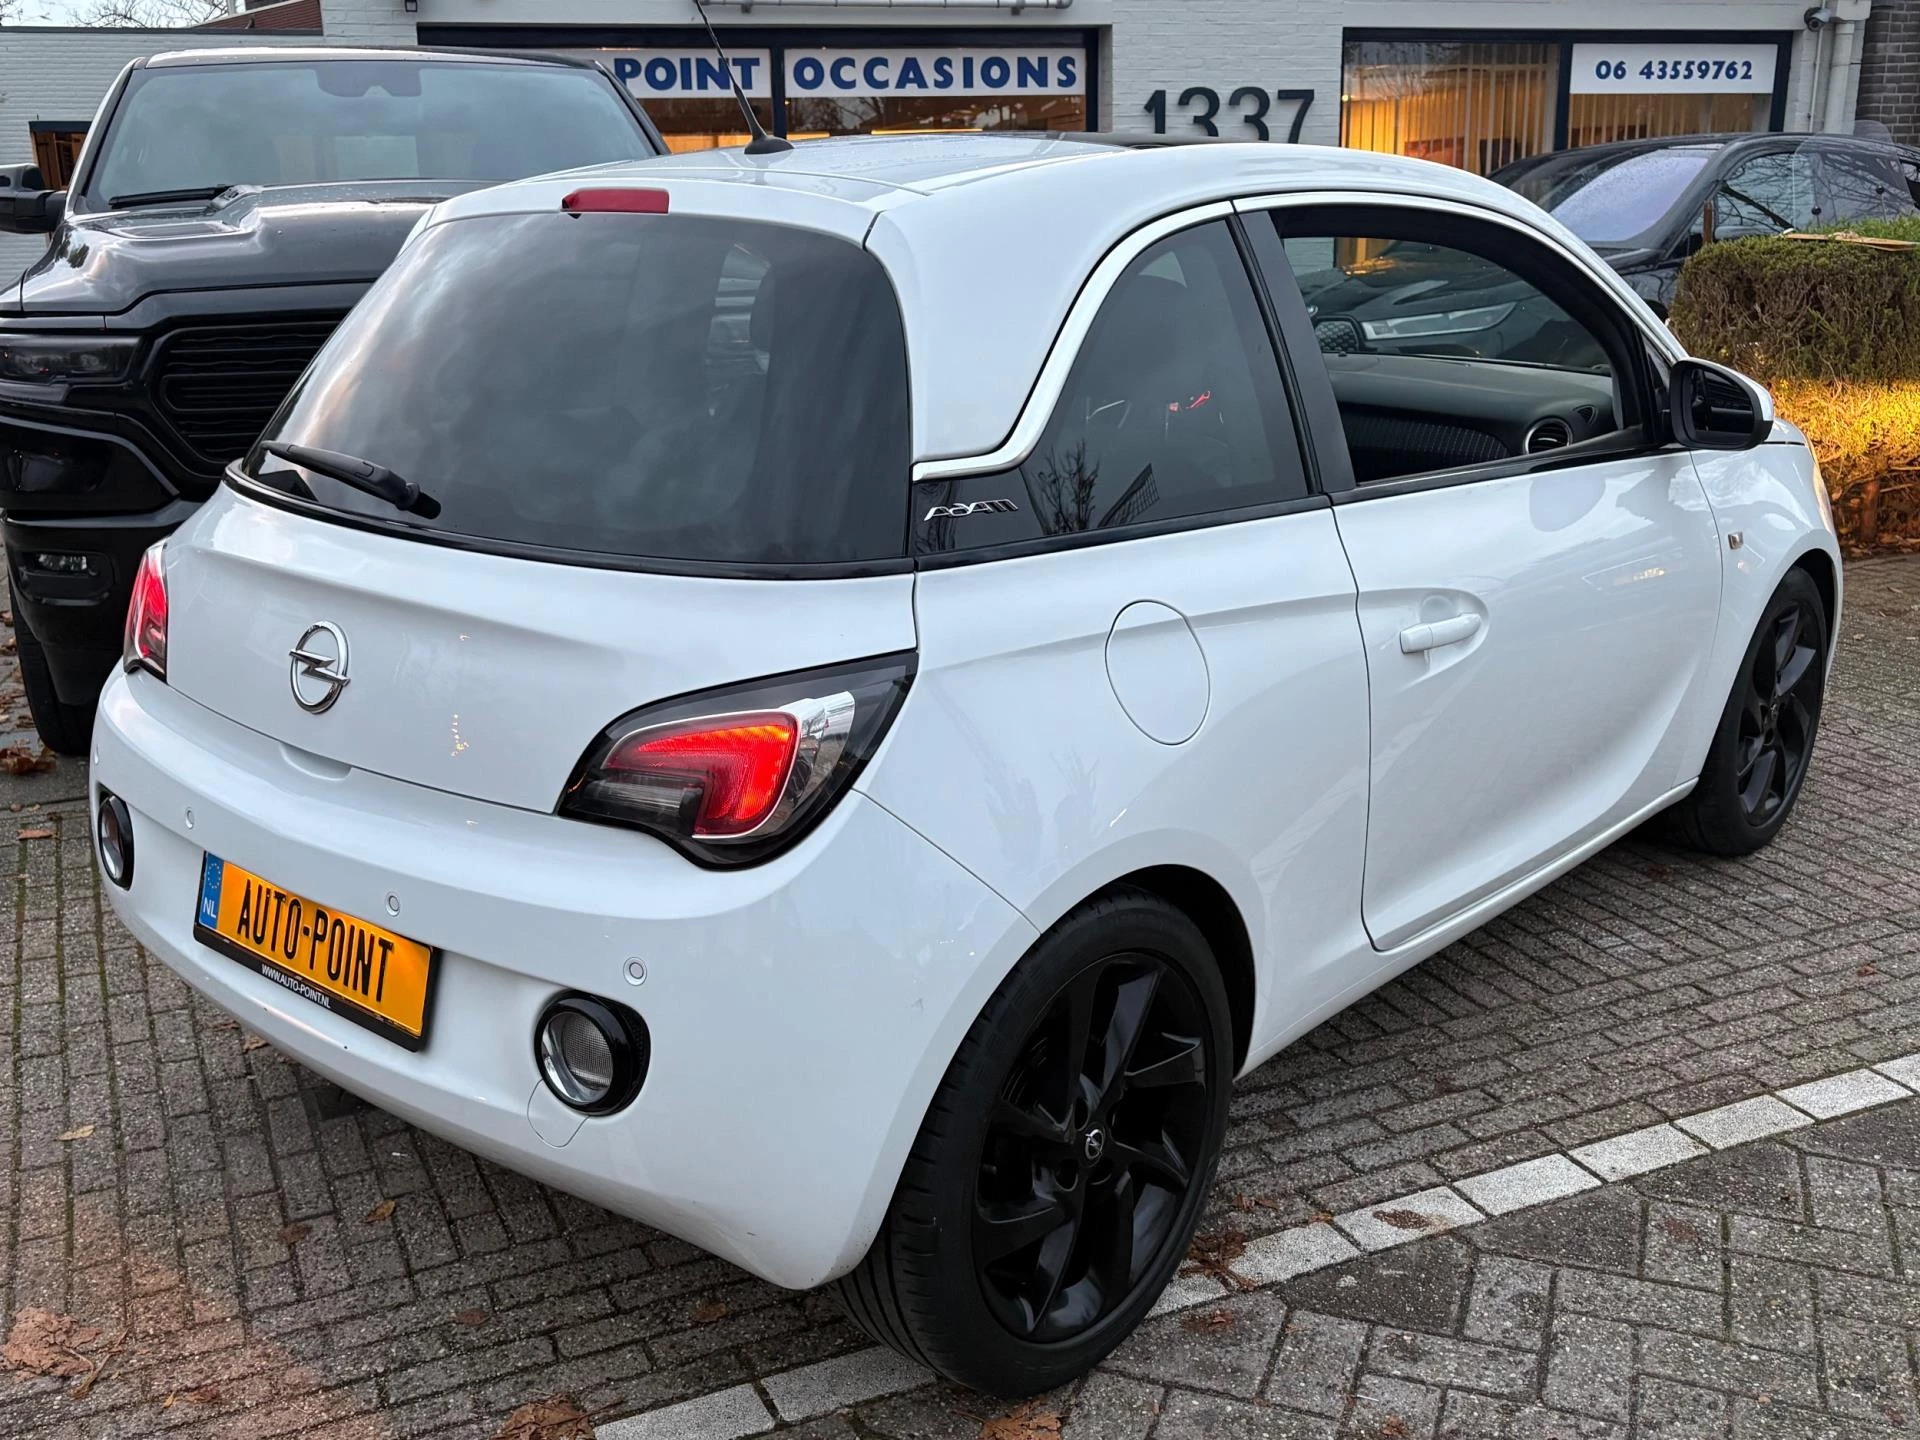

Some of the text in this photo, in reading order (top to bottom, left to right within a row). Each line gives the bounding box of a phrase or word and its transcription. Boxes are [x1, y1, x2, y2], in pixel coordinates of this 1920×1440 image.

[614, 55, 1077, 91] POINT OCCASIONS
[1595, 60, 1753, 80] 06 43559762
[1143, 86, 1315, 144] 1337
[203, 897, 216, 918] NL
[237, 878, 394, 1003] AUTO-POINT
[261, 963, 331, 1009] WWW.AUTO-POINT.NL
